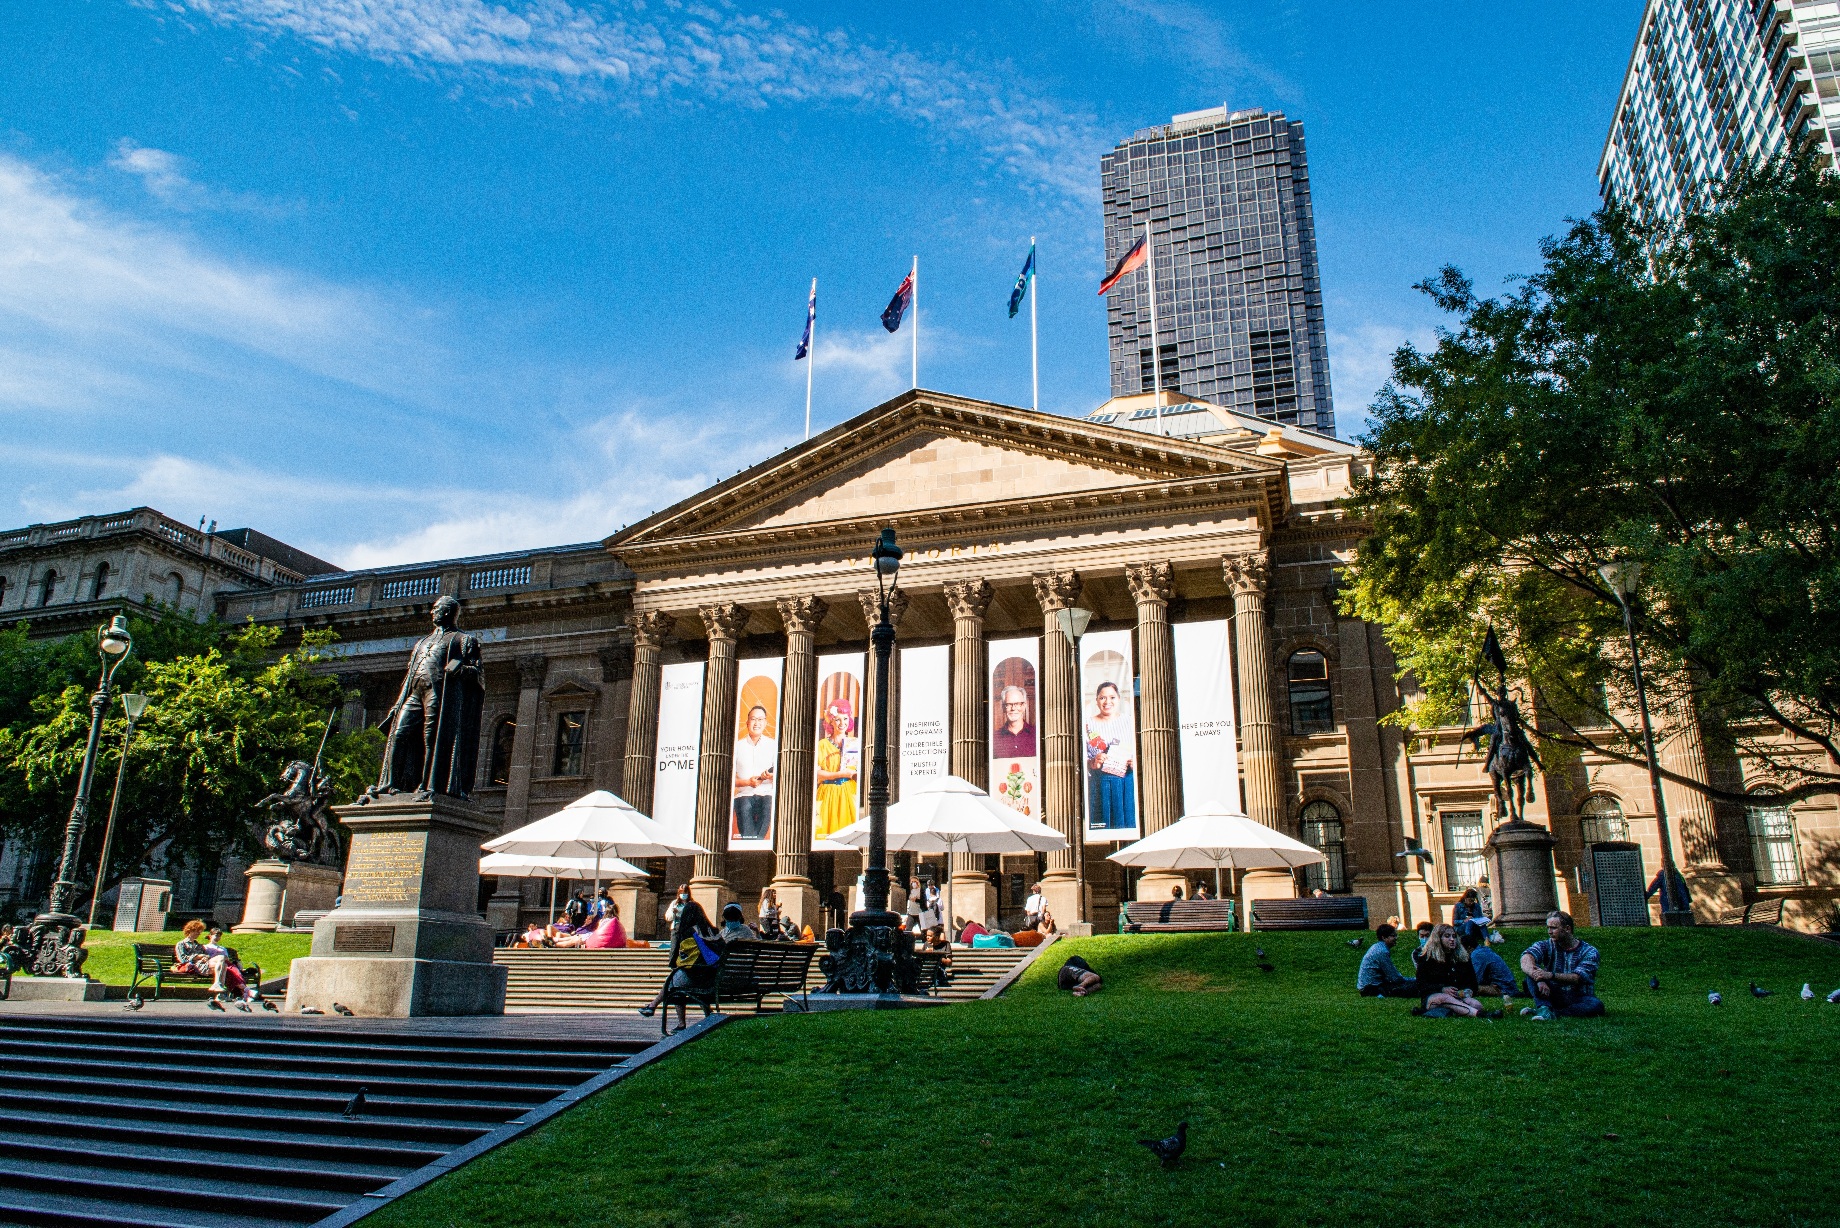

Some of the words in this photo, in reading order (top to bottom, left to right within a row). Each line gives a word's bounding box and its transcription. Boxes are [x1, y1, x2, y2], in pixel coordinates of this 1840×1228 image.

[846, 540, 1001, 566] VITORIA
[907, 720, 941, 728] INSPIRING
[905, 728, 942, 736] PROGRAMS
[1194, 729, 1221, 737] ALWAYS
[905, 740, 942, 748] INCREDIBLE
[902, 748, 946, 756] COLLECTIONS
[660, 759, 695, 771] DOME
